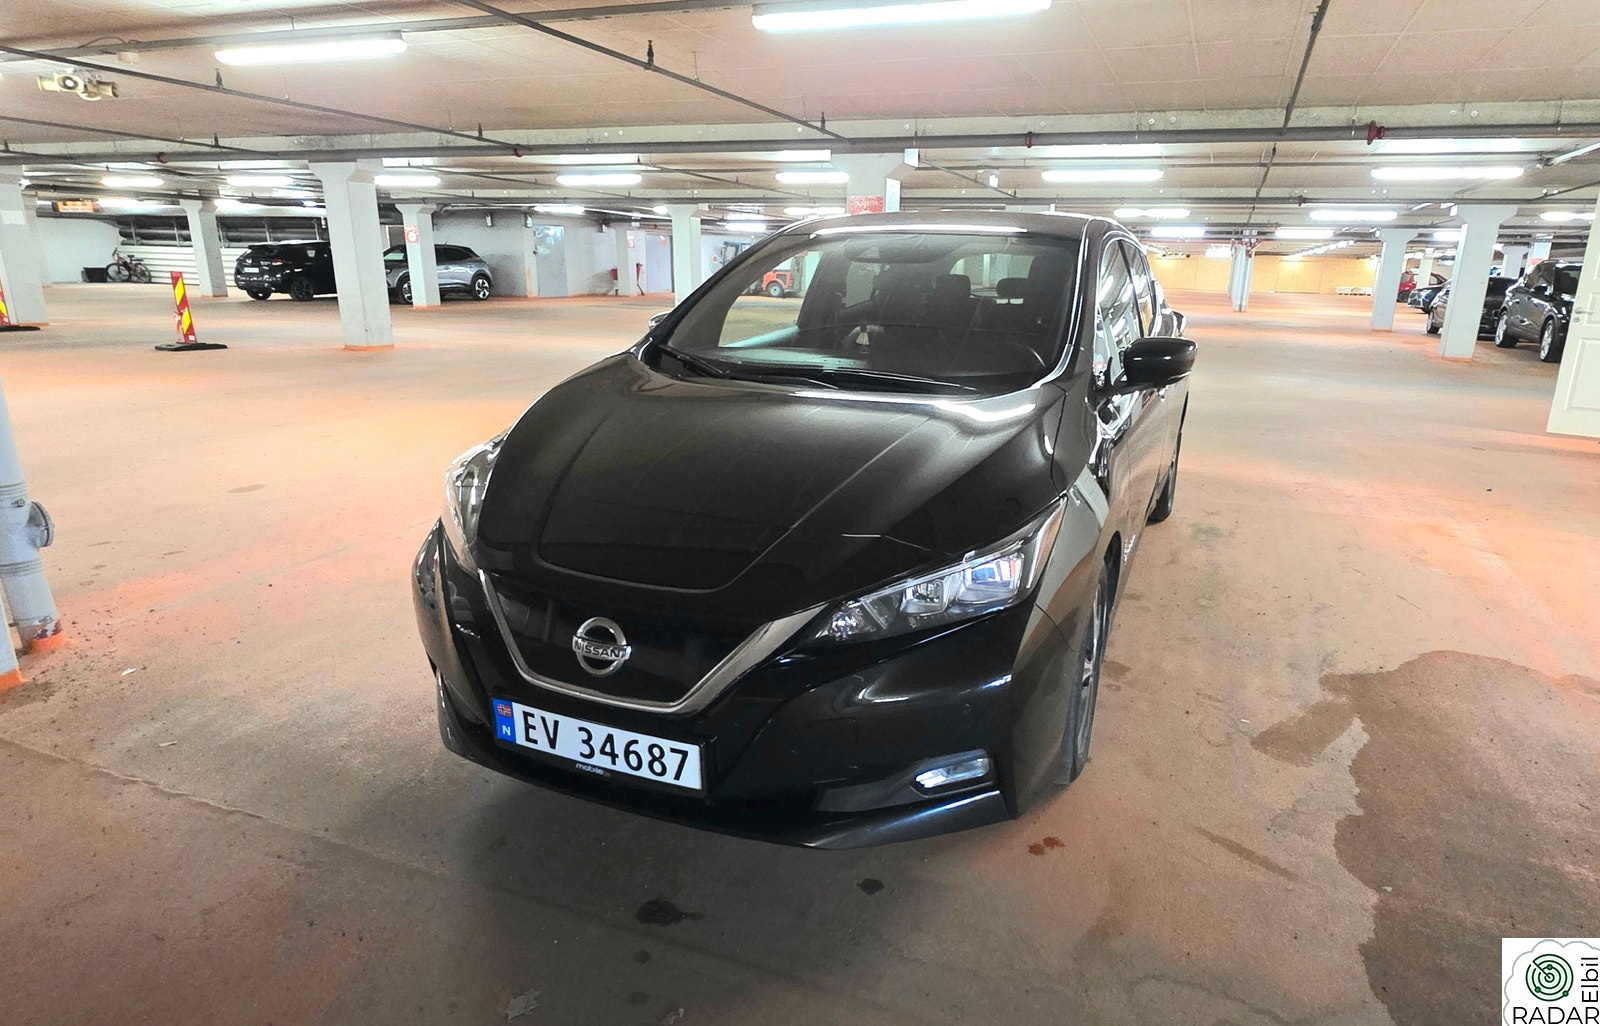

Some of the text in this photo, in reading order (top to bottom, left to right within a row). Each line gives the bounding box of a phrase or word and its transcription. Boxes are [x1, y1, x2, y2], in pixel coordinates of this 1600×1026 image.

[574, 640, 620, 658] NISSAN
[502, 725, 511, 736] N
[522, 711, 689, 781] EV 34687
